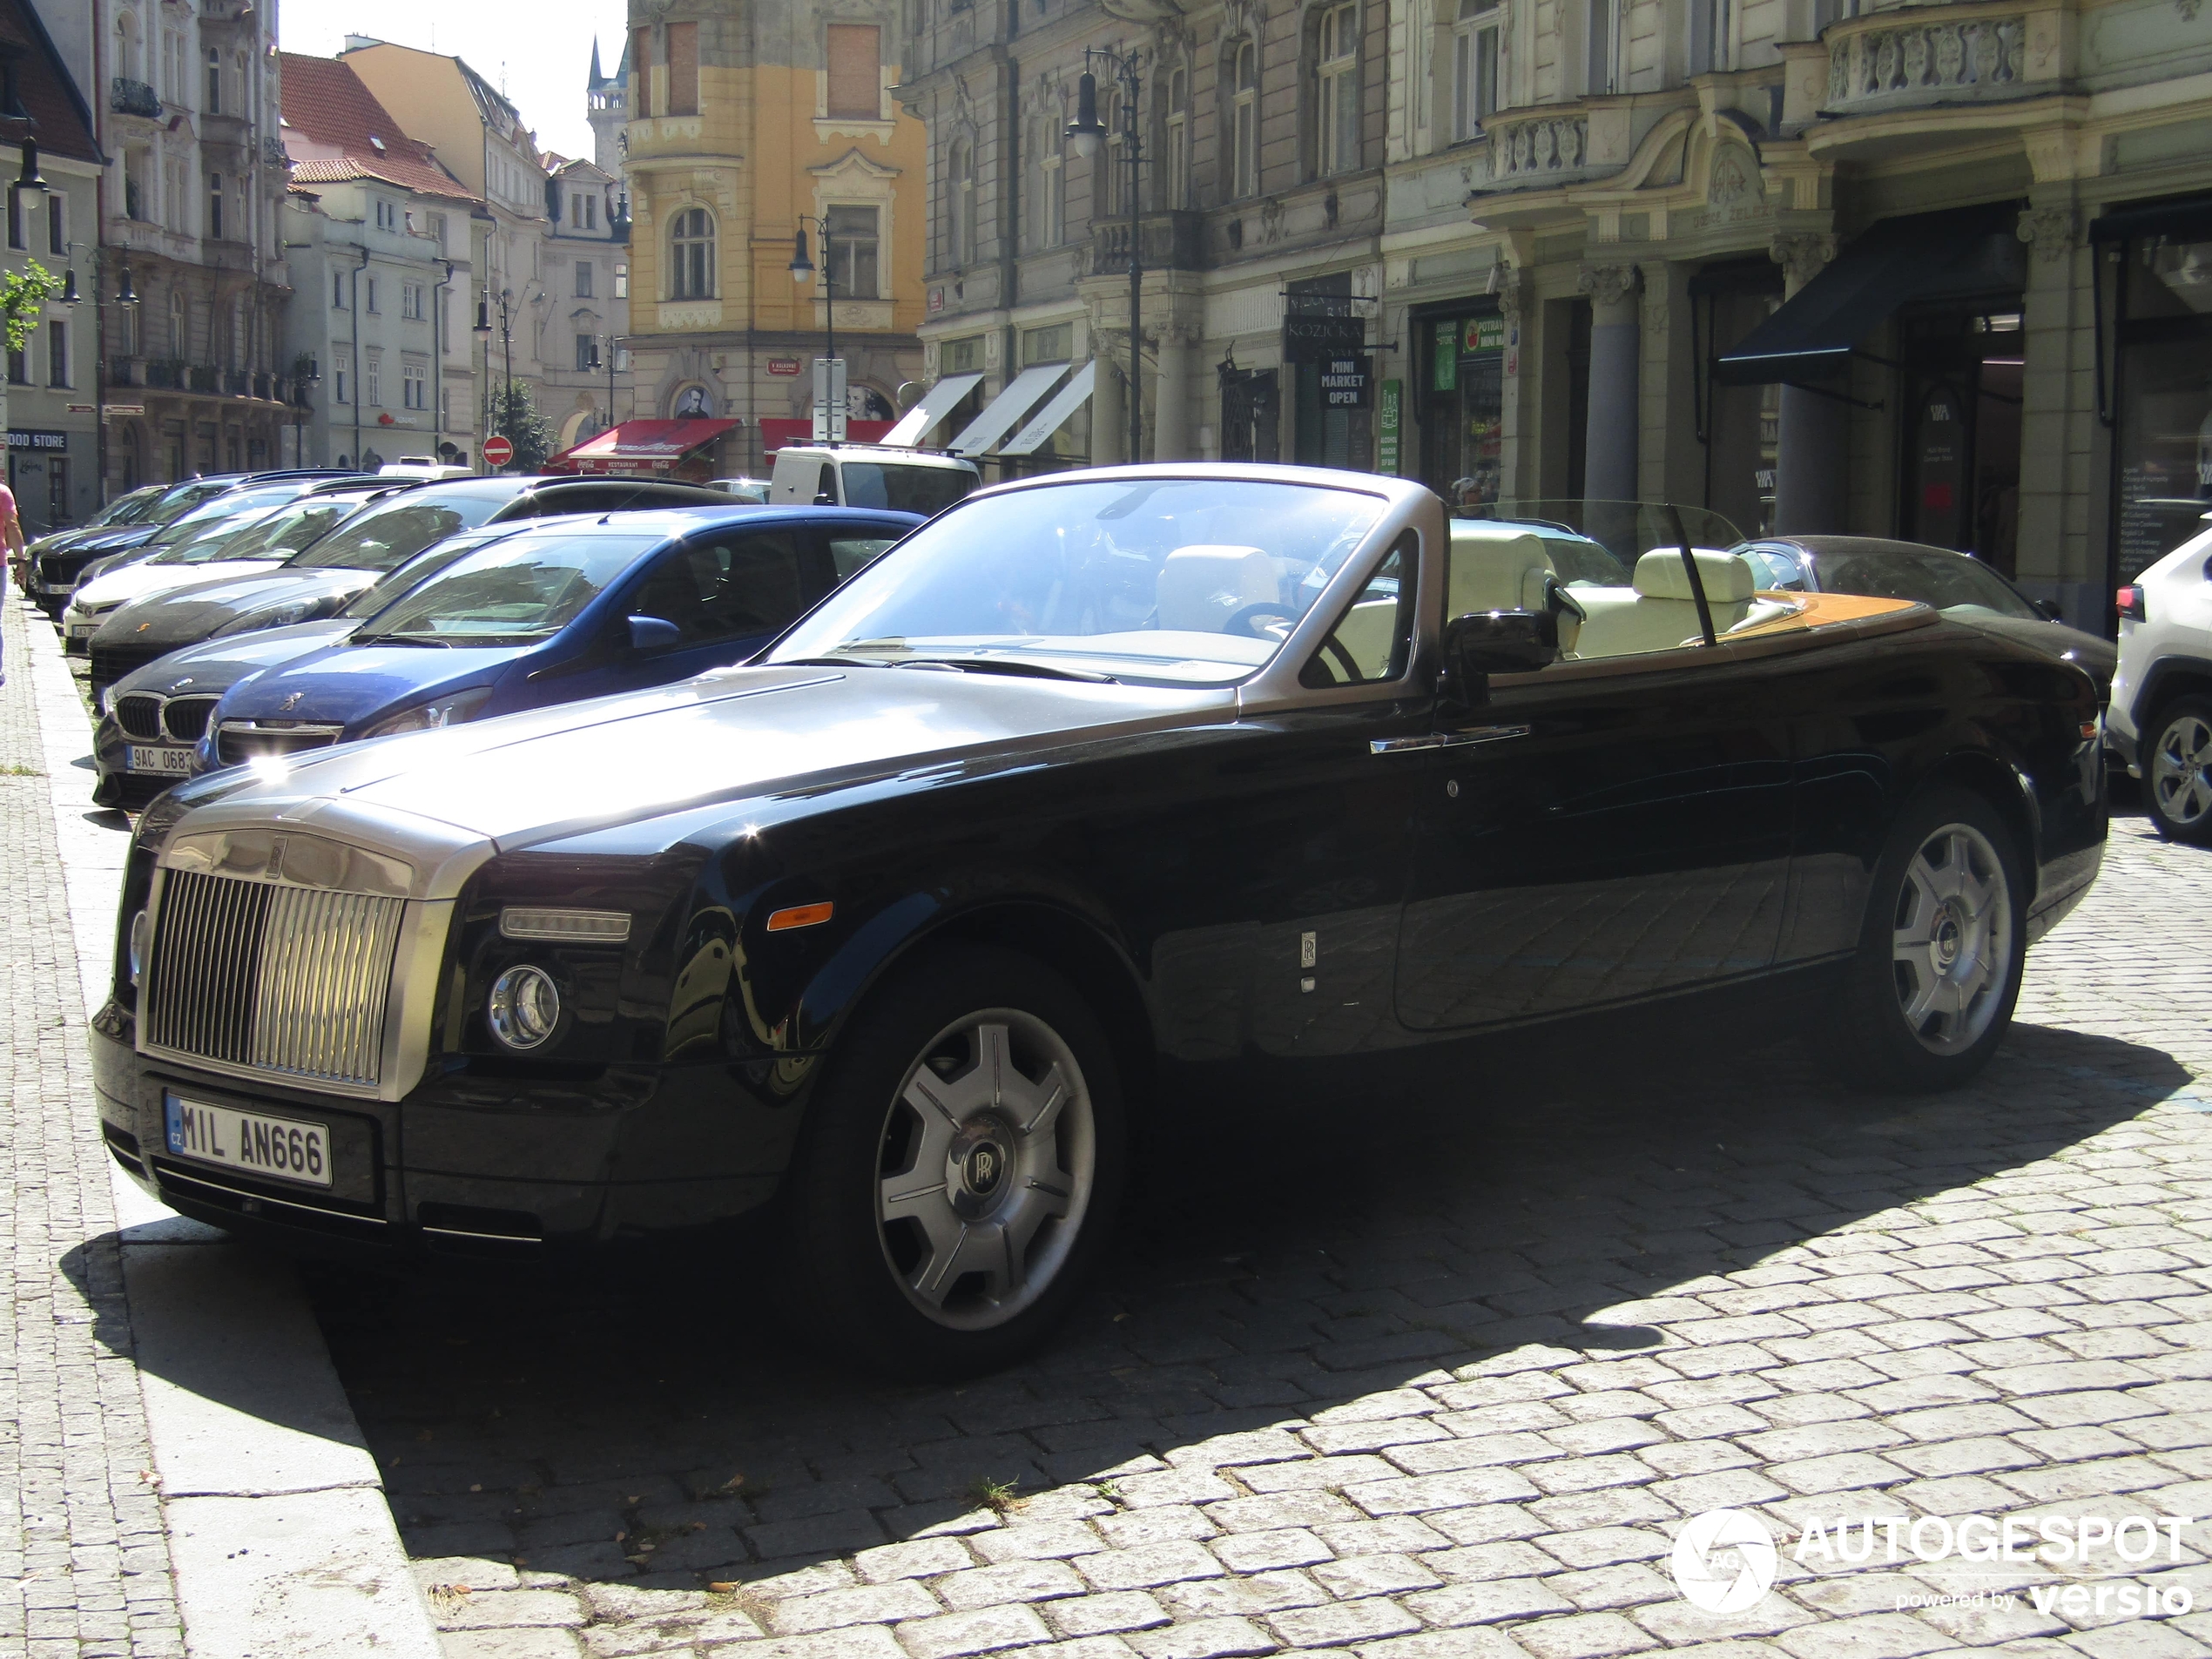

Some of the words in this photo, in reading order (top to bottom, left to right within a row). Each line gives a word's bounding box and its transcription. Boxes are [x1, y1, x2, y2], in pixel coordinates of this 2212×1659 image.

[1288, 320, 1362, 338] KOZIČKA
[1479, 319, 1503, 332] POTRAV
[1332, 361, 1354, 374] MINI
[1321, 375, 1365, 388] MARKET
[1329, 392, 1358, 404] OPEN
[8, 433, 30, 446] OOD
[34, 435, 64, 448] STORE
[134, 748, 154, 767] 9AC
[171, 1132, 182, 1147] CZ
[180, 1104, 226, 1157] MIL
[241, 1118, 323, 1177] AN666
